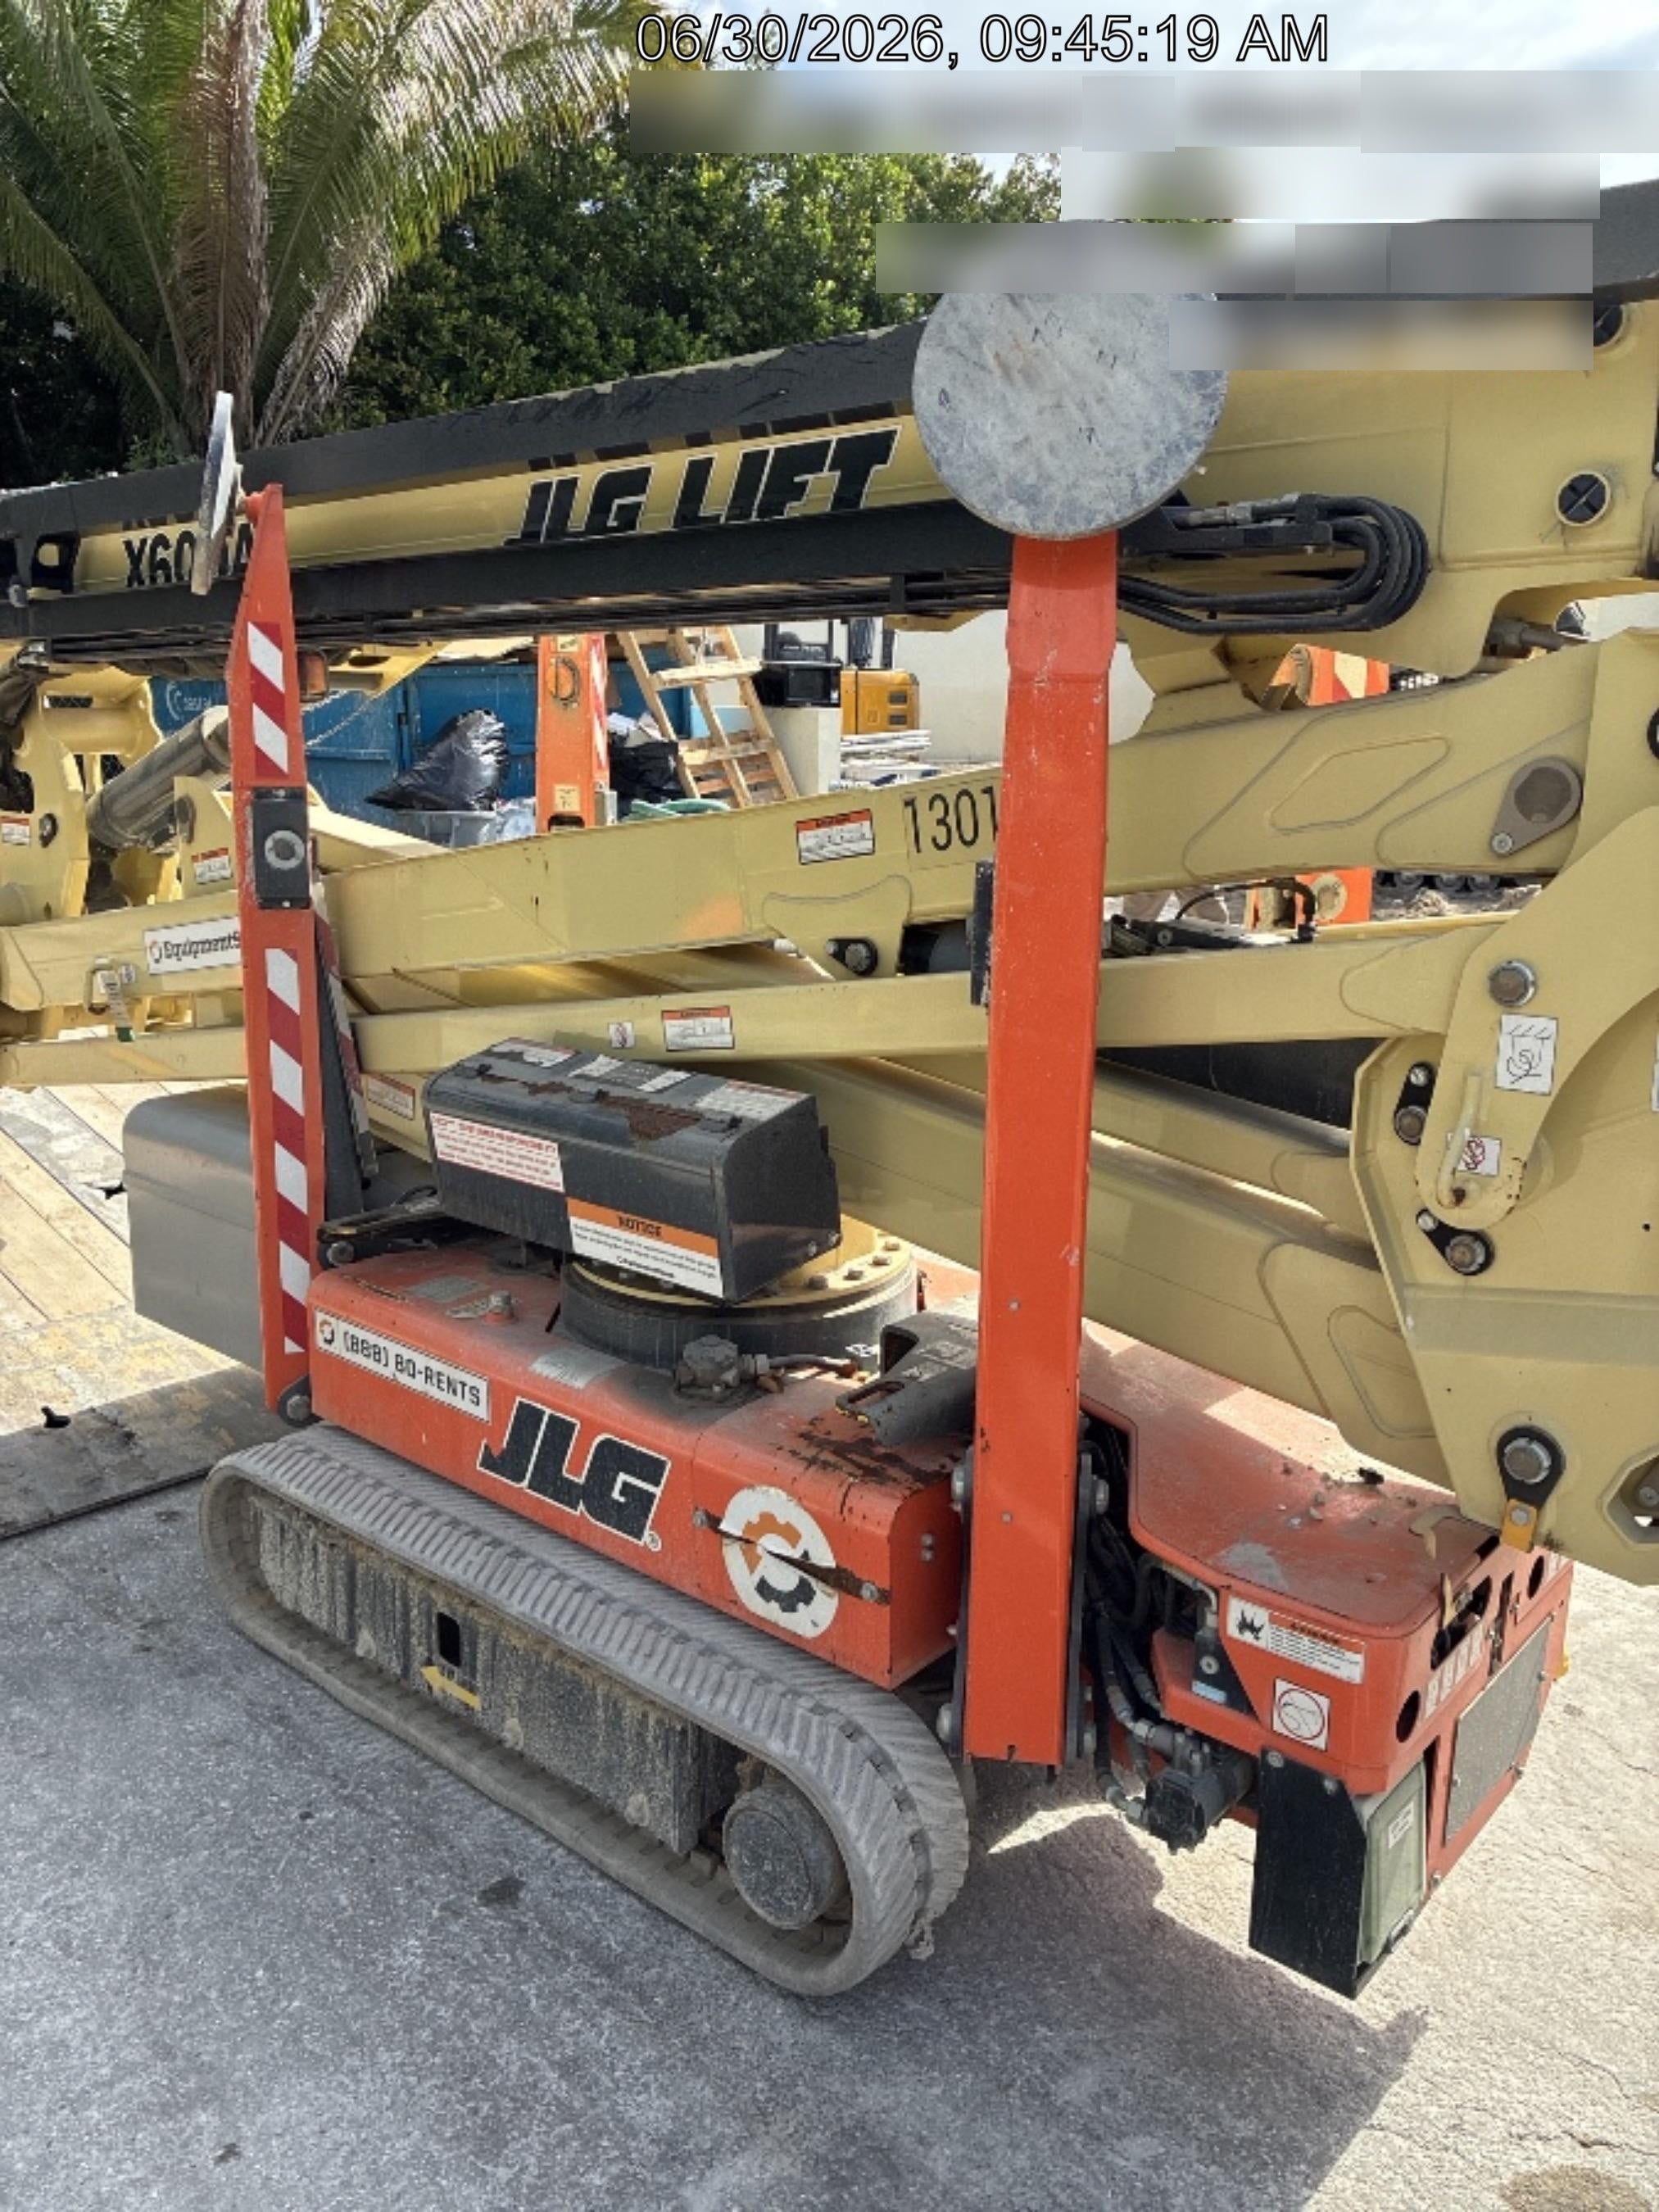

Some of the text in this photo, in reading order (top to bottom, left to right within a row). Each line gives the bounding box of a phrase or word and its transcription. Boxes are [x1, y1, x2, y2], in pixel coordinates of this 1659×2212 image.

[672, 425, 901, 529] LIFT
[617, 1213, 664, 1239] NOTICE
[342, 1329, 389, 1368] (888)
